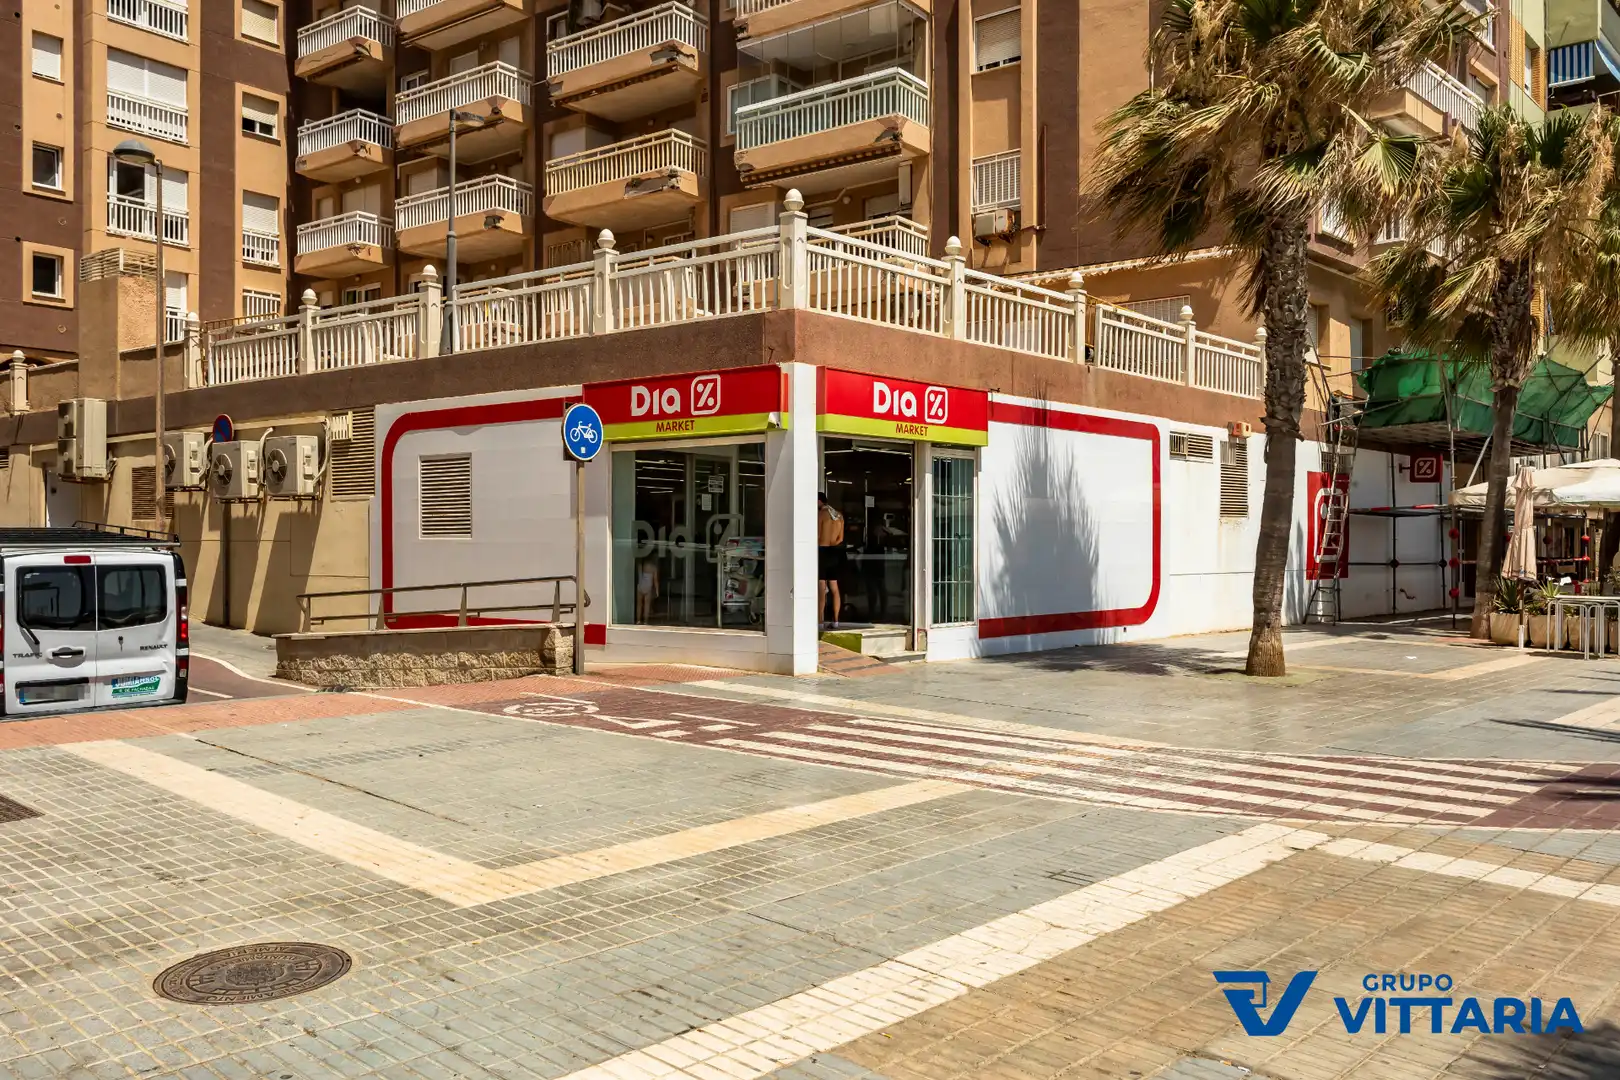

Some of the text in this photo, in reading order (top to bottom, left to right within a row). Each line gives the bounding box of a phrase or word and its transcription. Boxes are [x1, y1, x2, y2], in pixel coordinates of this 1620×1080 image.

[656, 420, 695, 433] MARKET
[896, 423, 929, 436] MARKET
[139, 643, 168, 651] RENAULT
